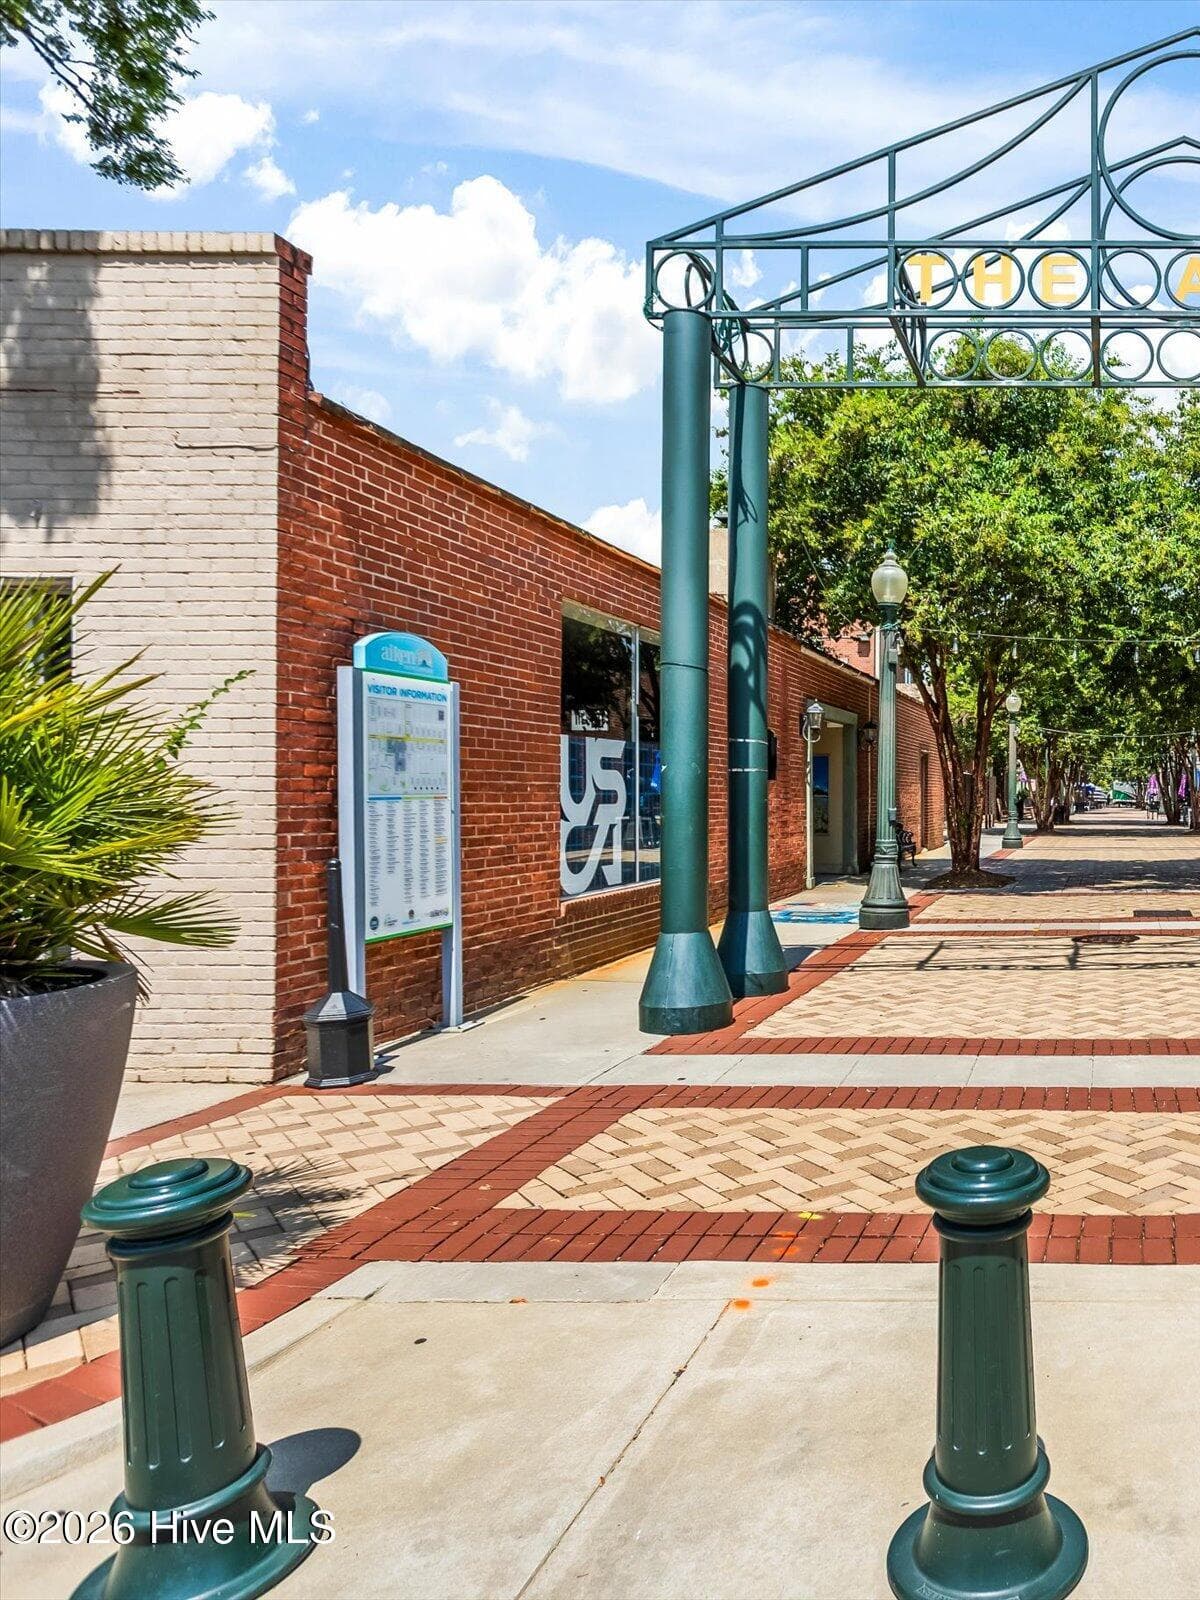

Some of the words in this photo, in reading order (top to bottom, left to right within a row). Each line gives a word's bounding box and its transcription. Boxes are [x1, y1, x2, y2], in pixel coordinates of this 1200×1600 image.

[908, 254, 1078, 303] THE
[367, 684, 397, 696] VISITOR
[400, 689, 448, 702] INFORMATION
